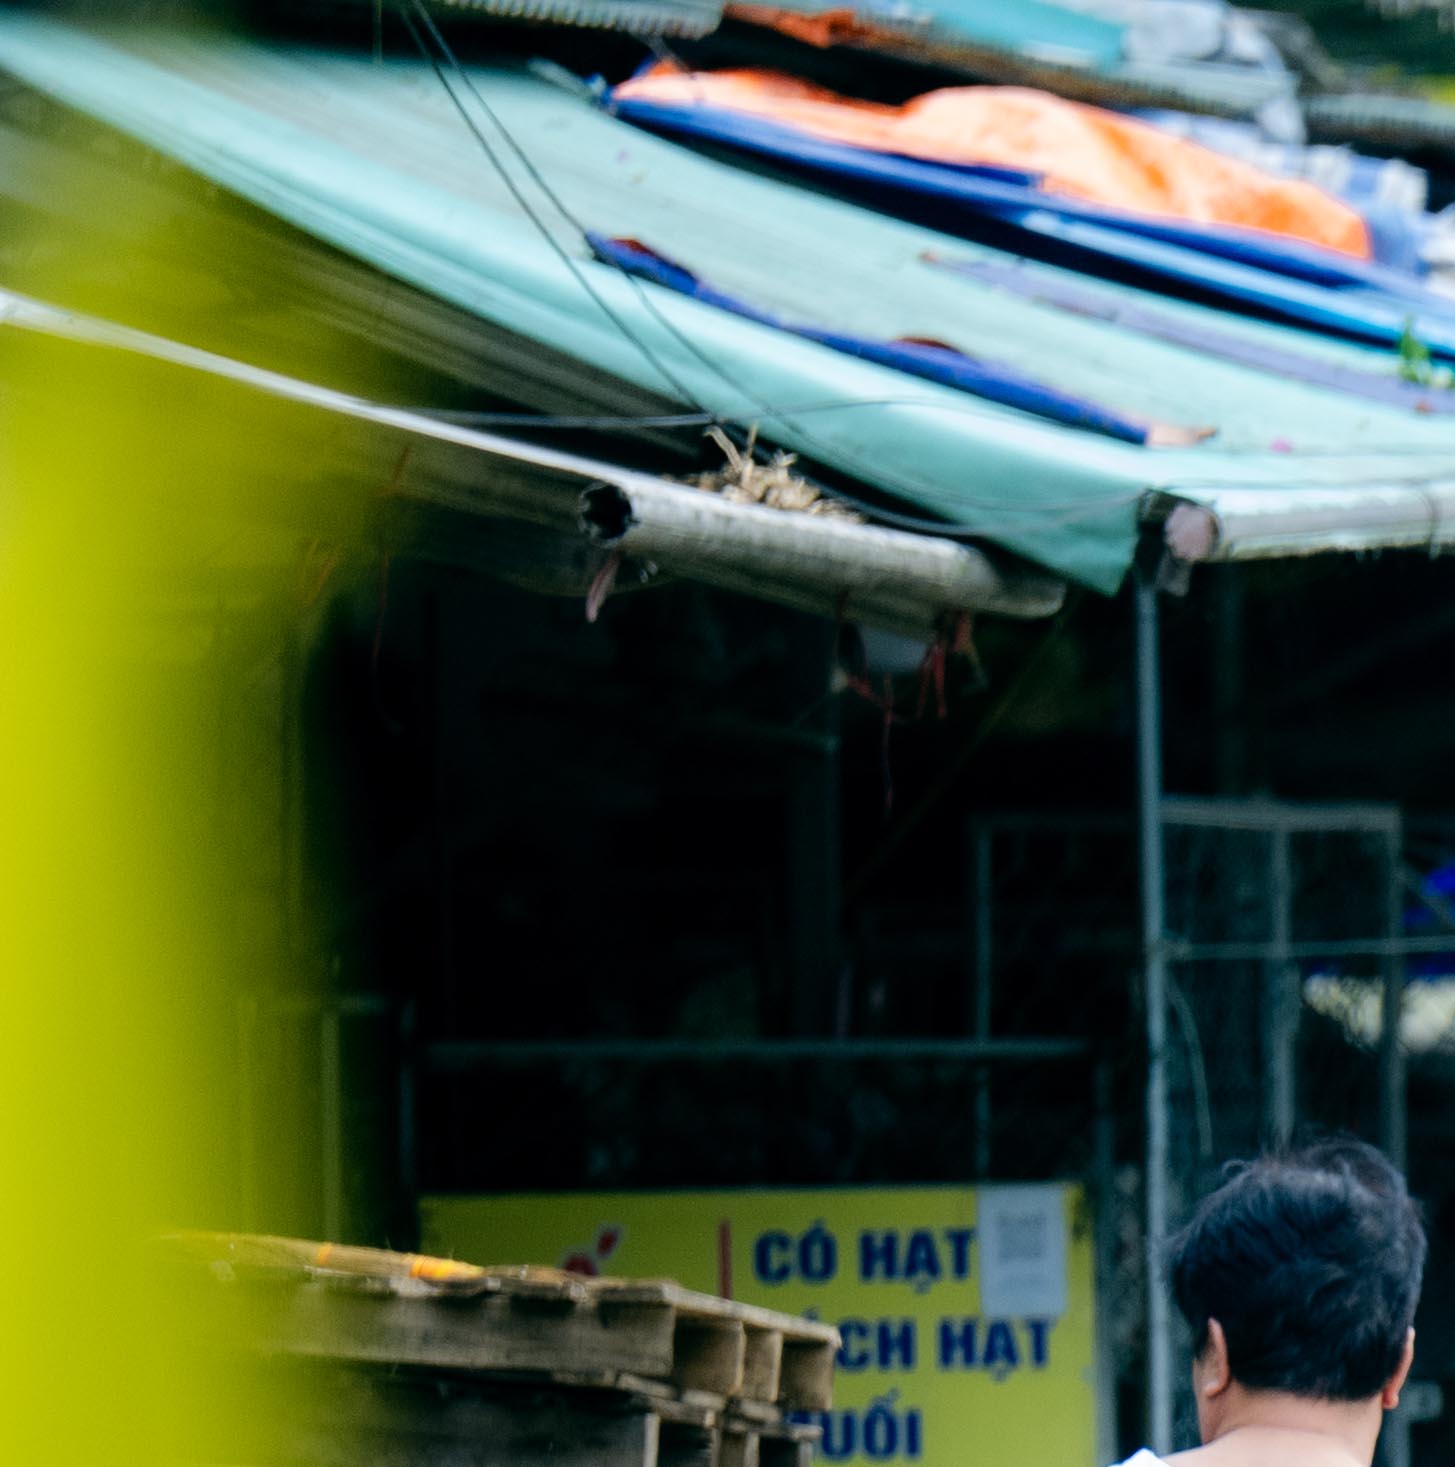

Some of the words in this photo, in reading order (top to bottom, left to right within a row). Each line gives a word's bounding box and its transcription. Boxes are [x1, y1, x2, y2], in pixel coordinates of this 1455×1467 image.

[754, 1219, 838, 1284] CÓ
[858, 1228, 977, 1293] HẠT
[938, 1317, 1057, 1381] HẠT
[786, 1388, 922, 1463] UỐI
